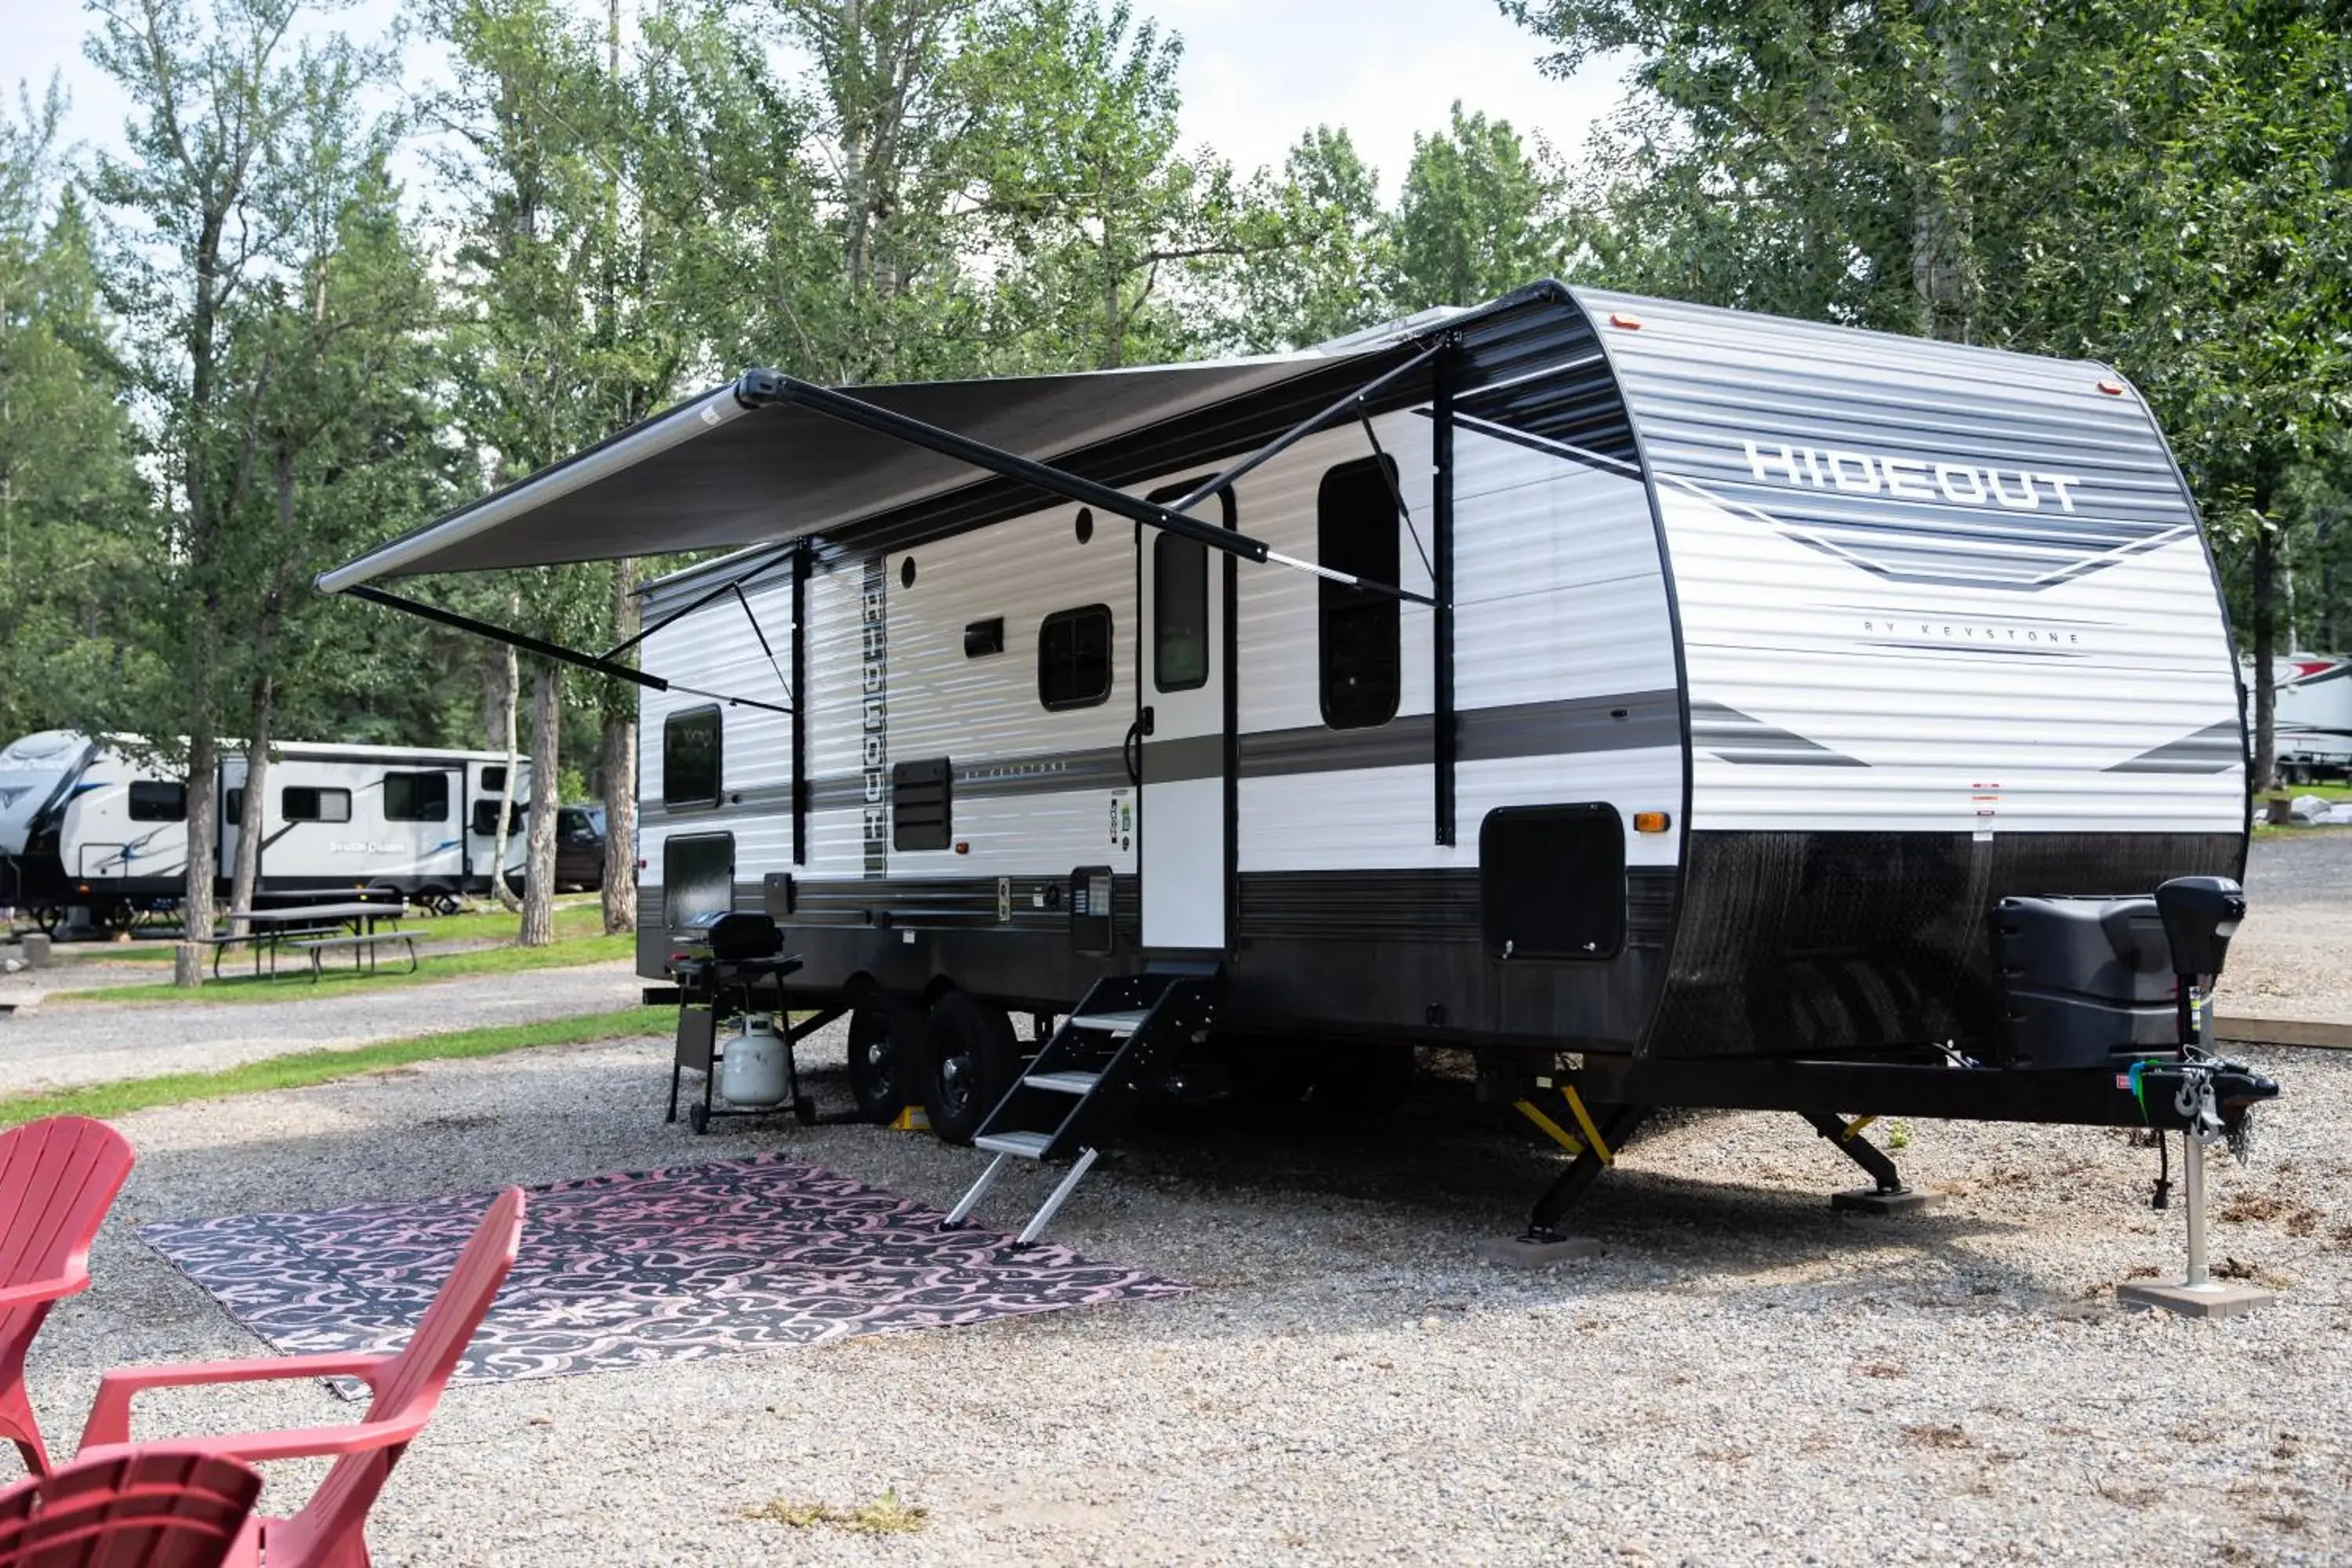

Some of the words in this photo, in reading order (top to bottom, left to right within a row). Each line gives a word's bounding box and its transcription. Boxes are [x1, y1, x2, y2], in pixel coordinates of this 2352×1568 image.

[1742, 438, 2082, 513] HIDEOUT
[1921, 624, 2079, 644] KEYSTONE
[864, 593, 883, 840] HIDEOUT
